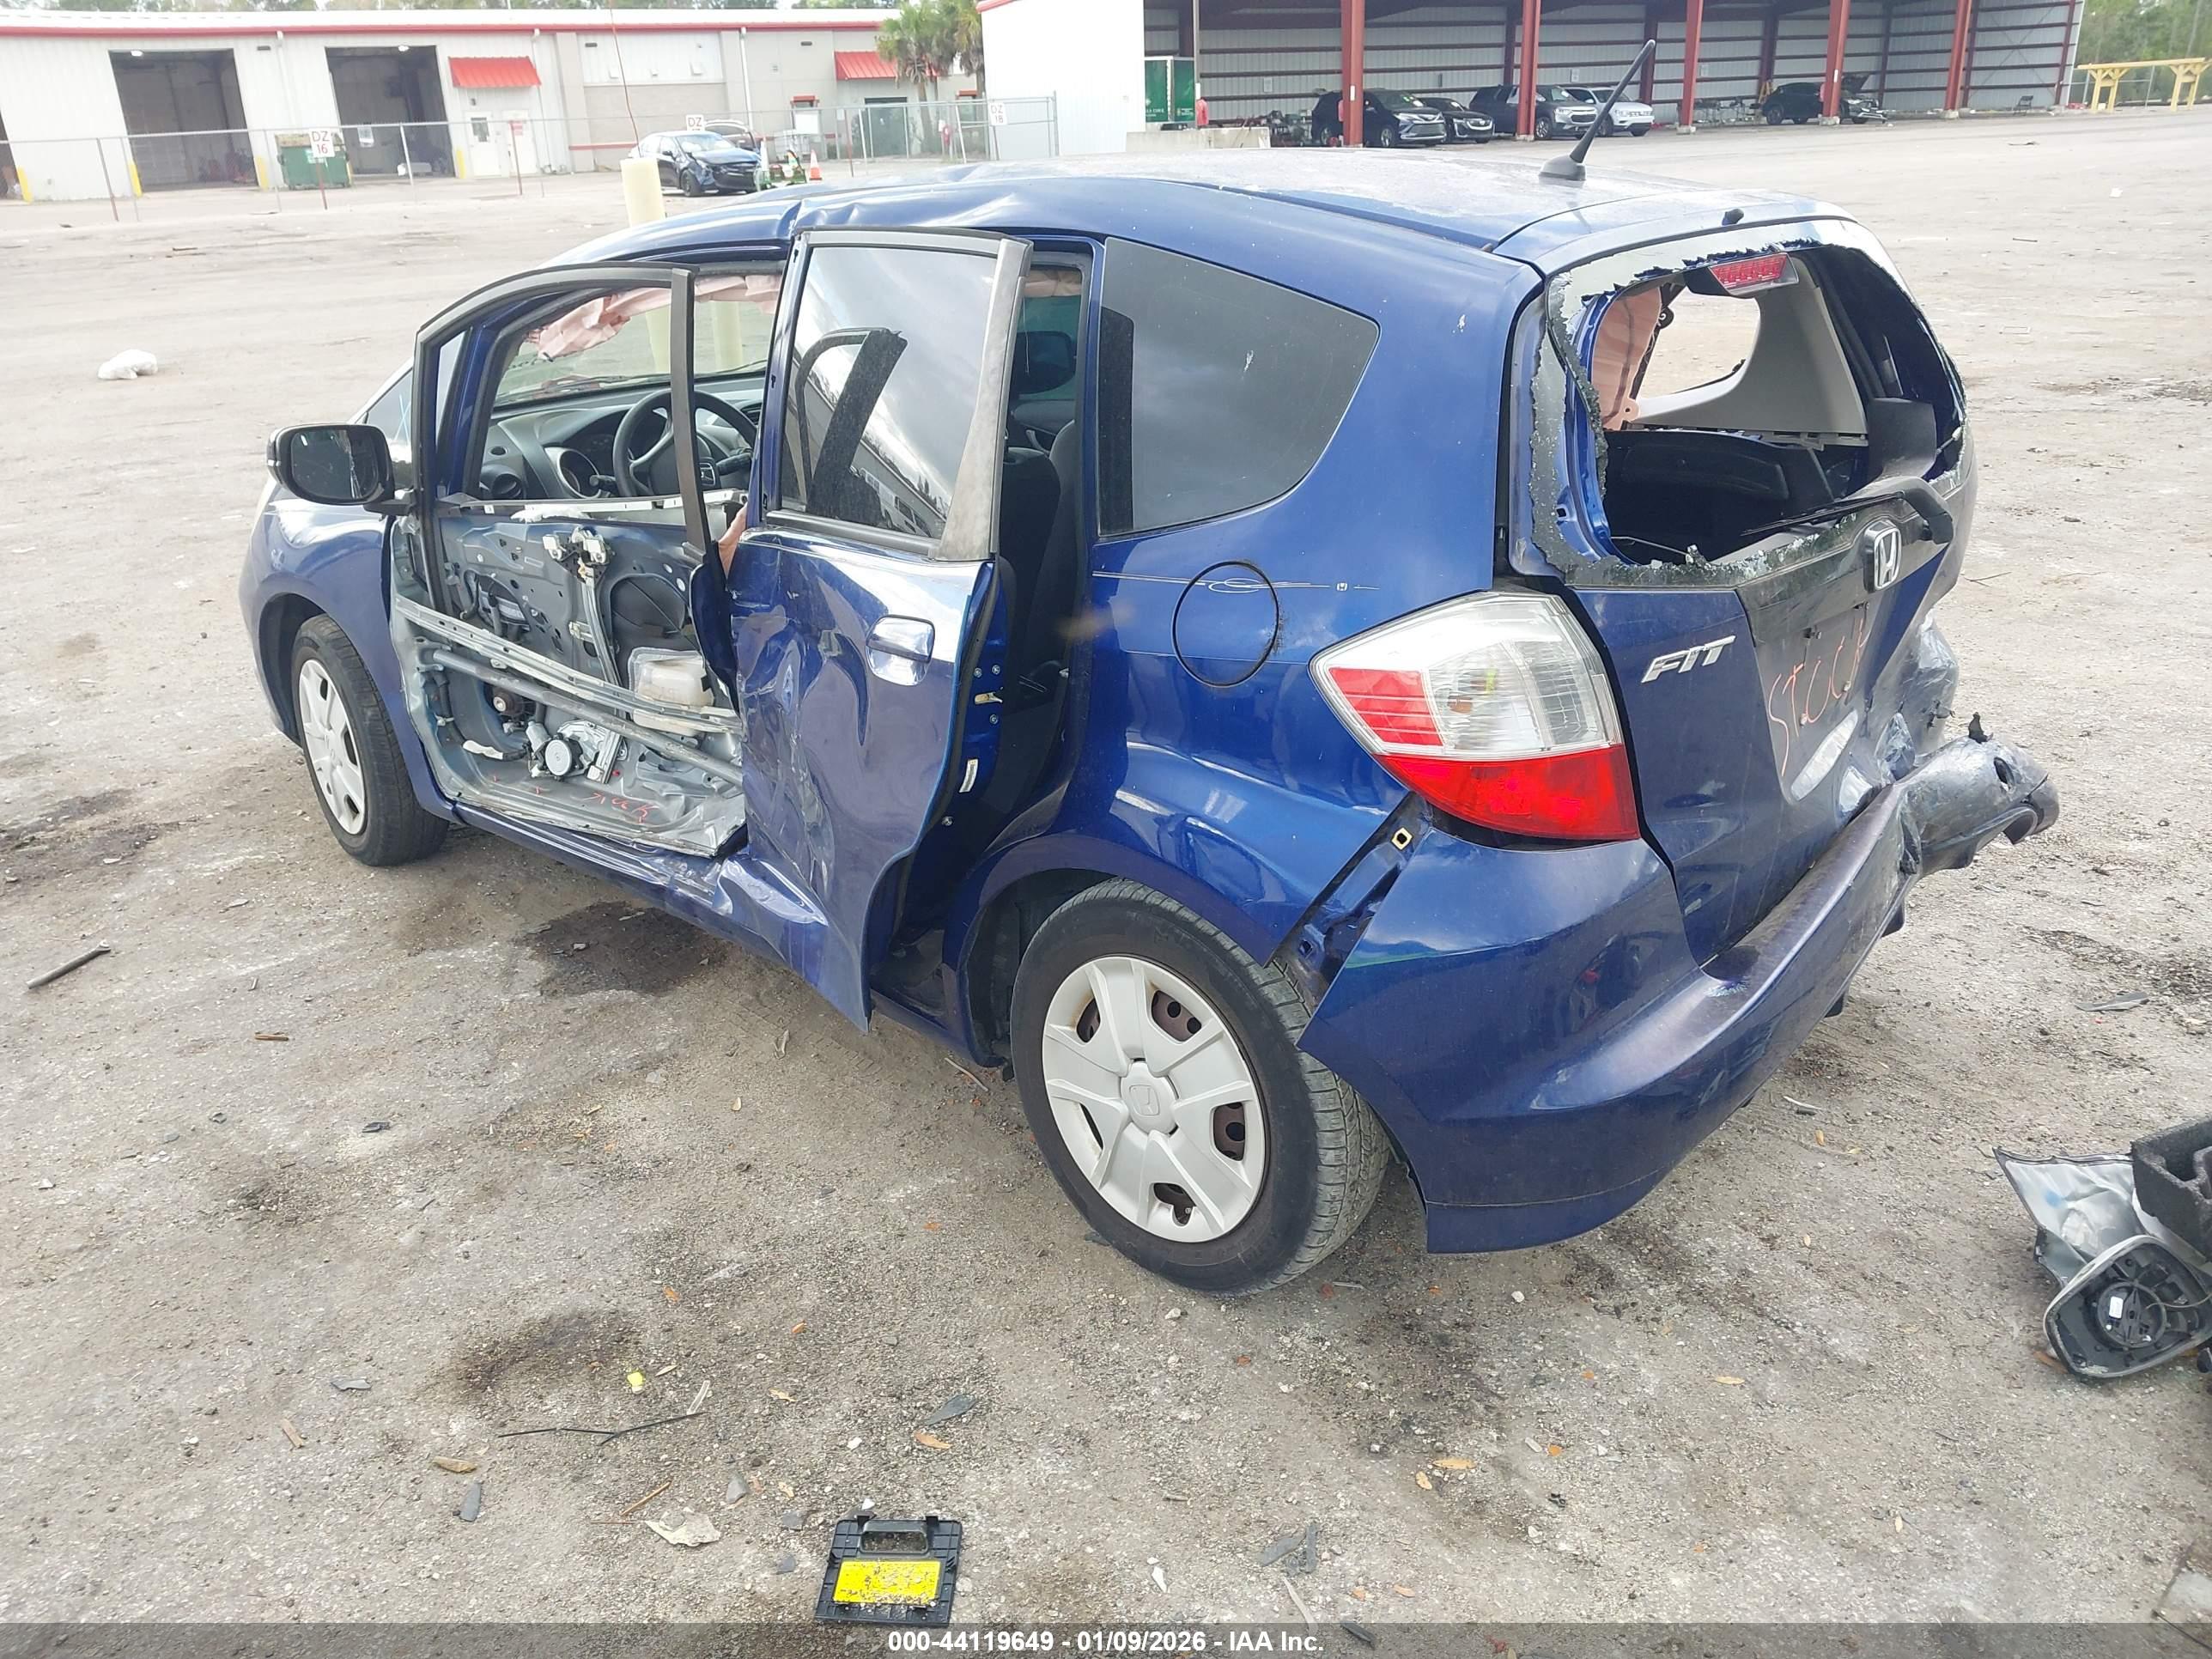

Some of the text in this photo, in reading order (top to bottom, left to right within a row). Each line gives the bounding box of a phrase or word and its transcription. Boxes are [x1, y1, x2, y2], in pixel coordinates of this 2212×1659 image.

[688, 117, 702, 127] DZ
[311, 131, 331, 142] DZ
[316, 143, 328, 155] 16
[1641, 635, 1736, 684] FIT
